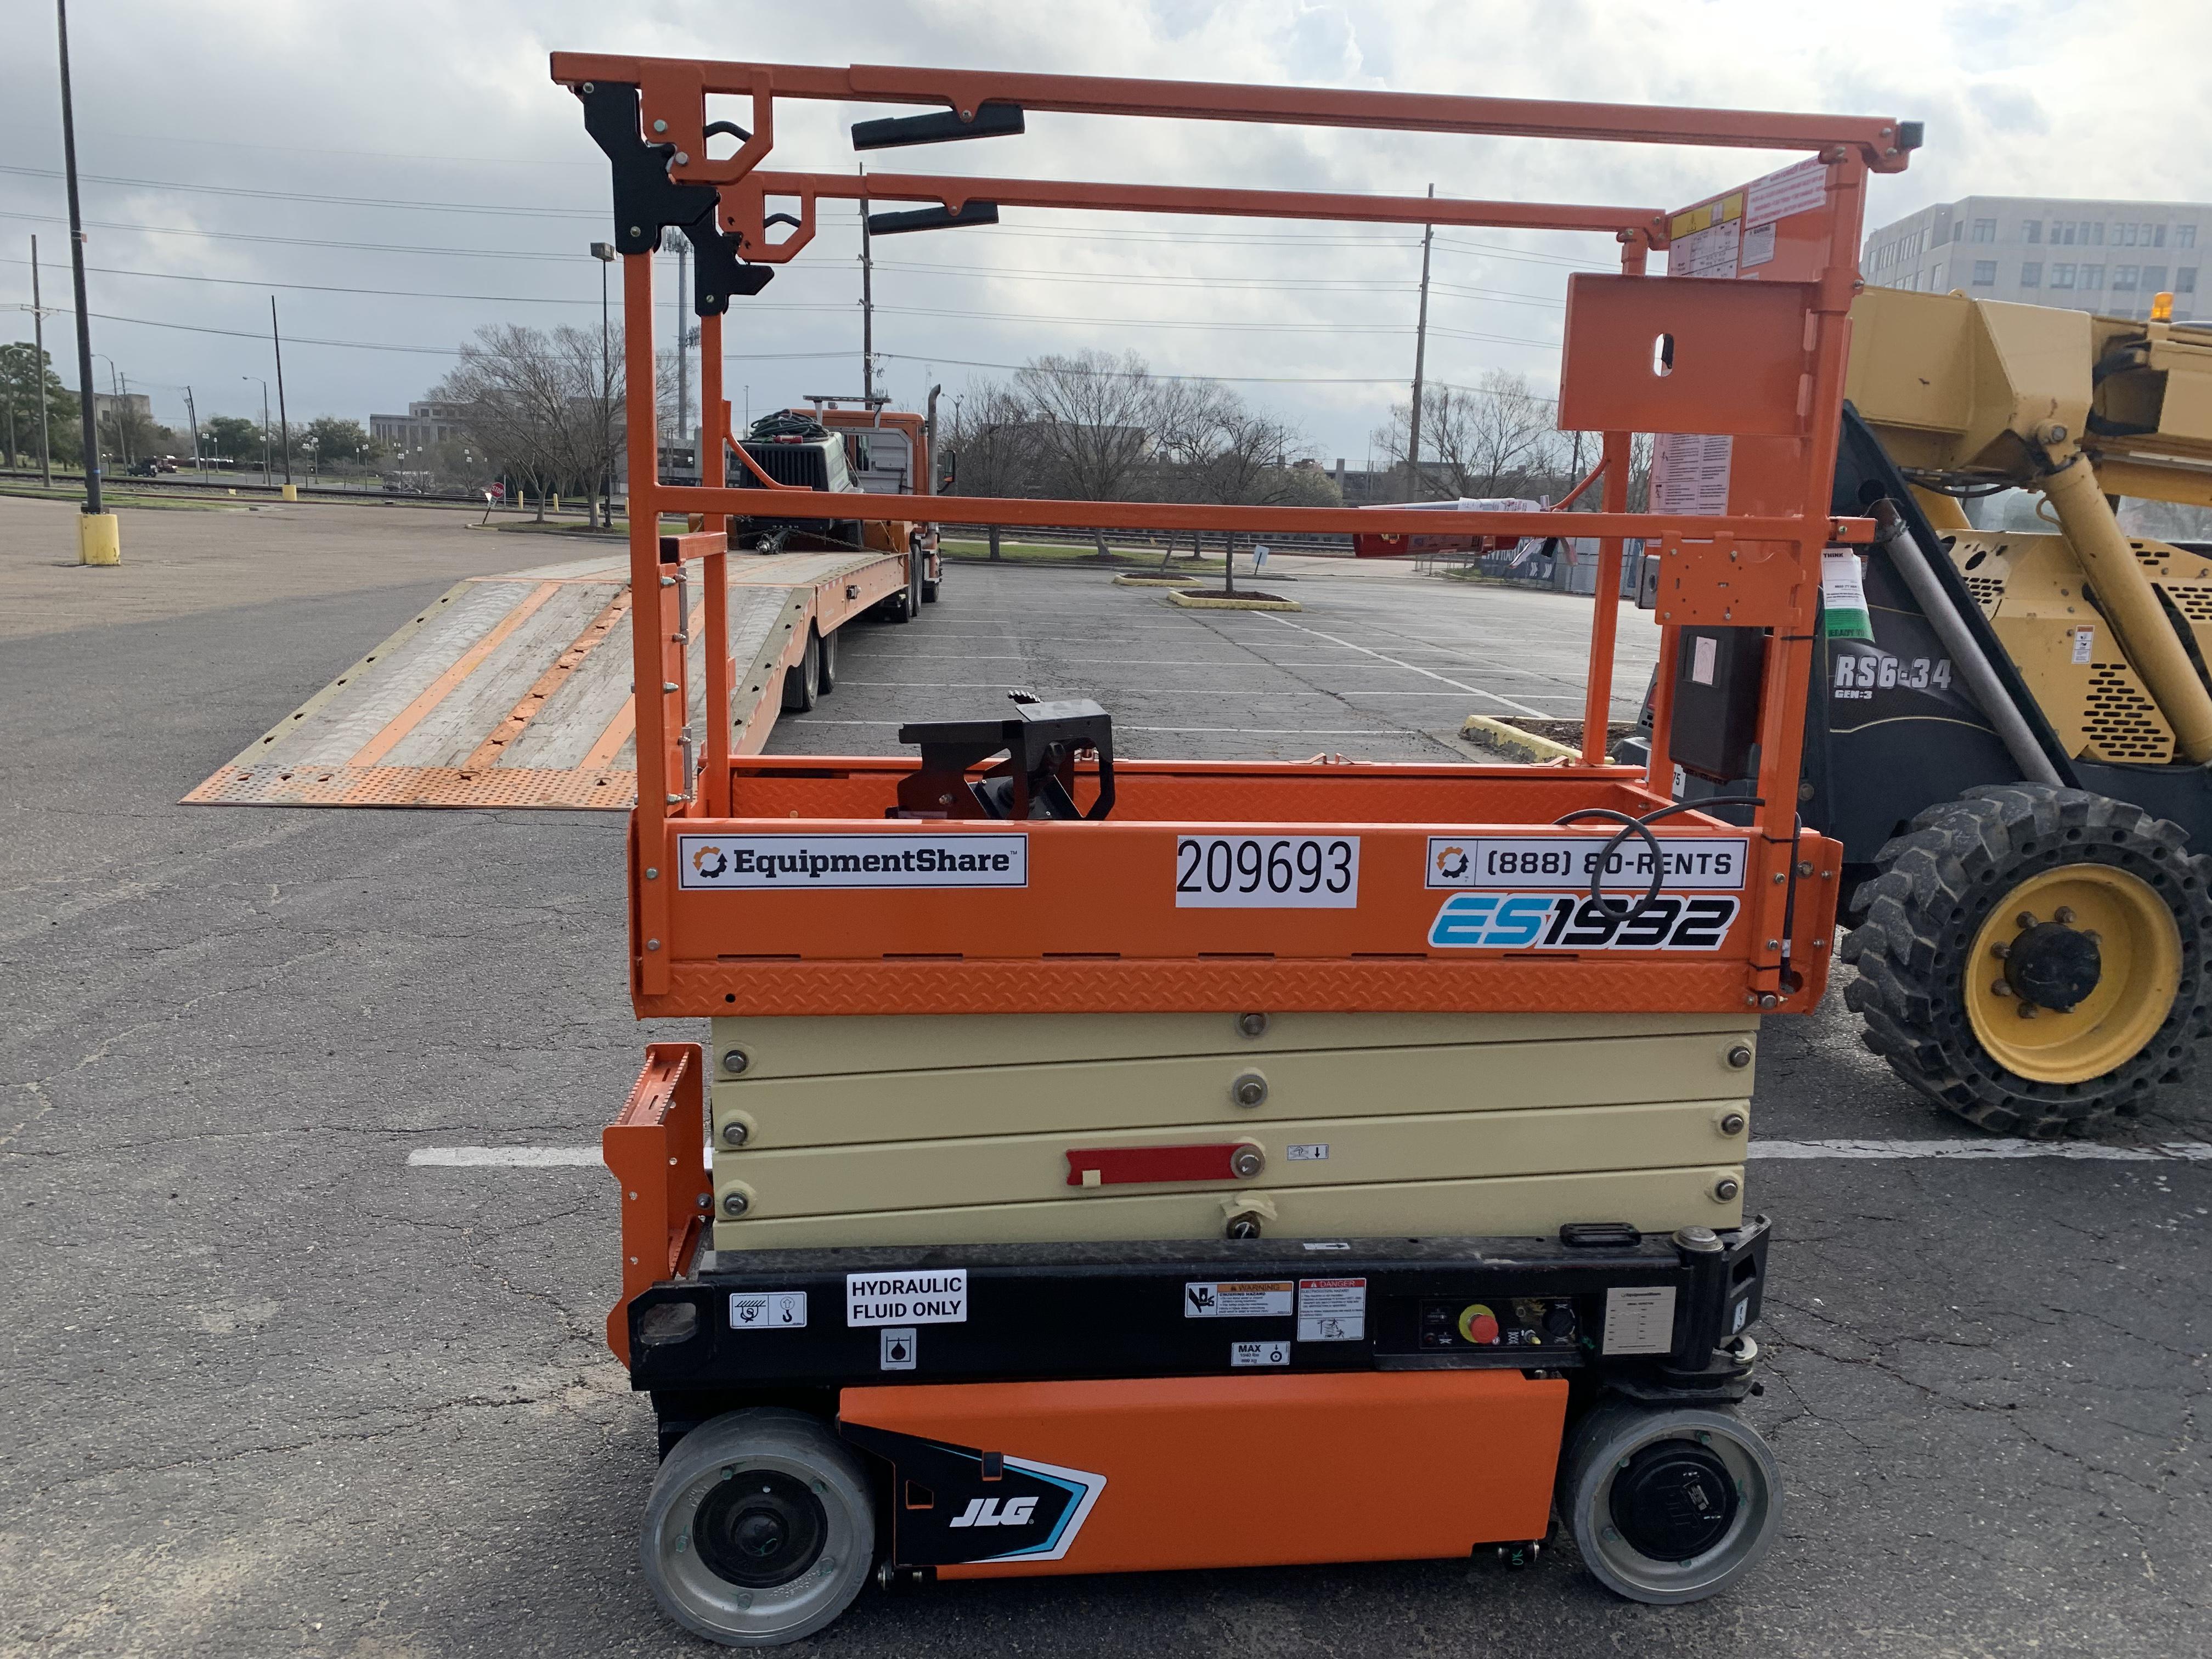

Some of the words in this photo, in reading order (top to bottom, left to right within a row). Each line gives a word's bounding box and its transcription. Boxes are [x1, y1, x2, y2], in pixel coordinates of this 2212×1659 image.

[492, 486, 504, 494] STOP
[1835, 654, 1951, 690] RS6-34
[733, 848, 1010, 878] EquipmentShare
[1176, 839, 1352, 893] 209693
[1488, 850, 1571, 877] (888)
[1584, 853, 1732, 874] 80-RENTS
[852, 1277, 962, 1296] HYDRAULIC
[853, 1303, 907, 1319] FLUID
[913, 1300, 962, 1316] ONLY
[949, 1497, 1039, 1527] JLG
